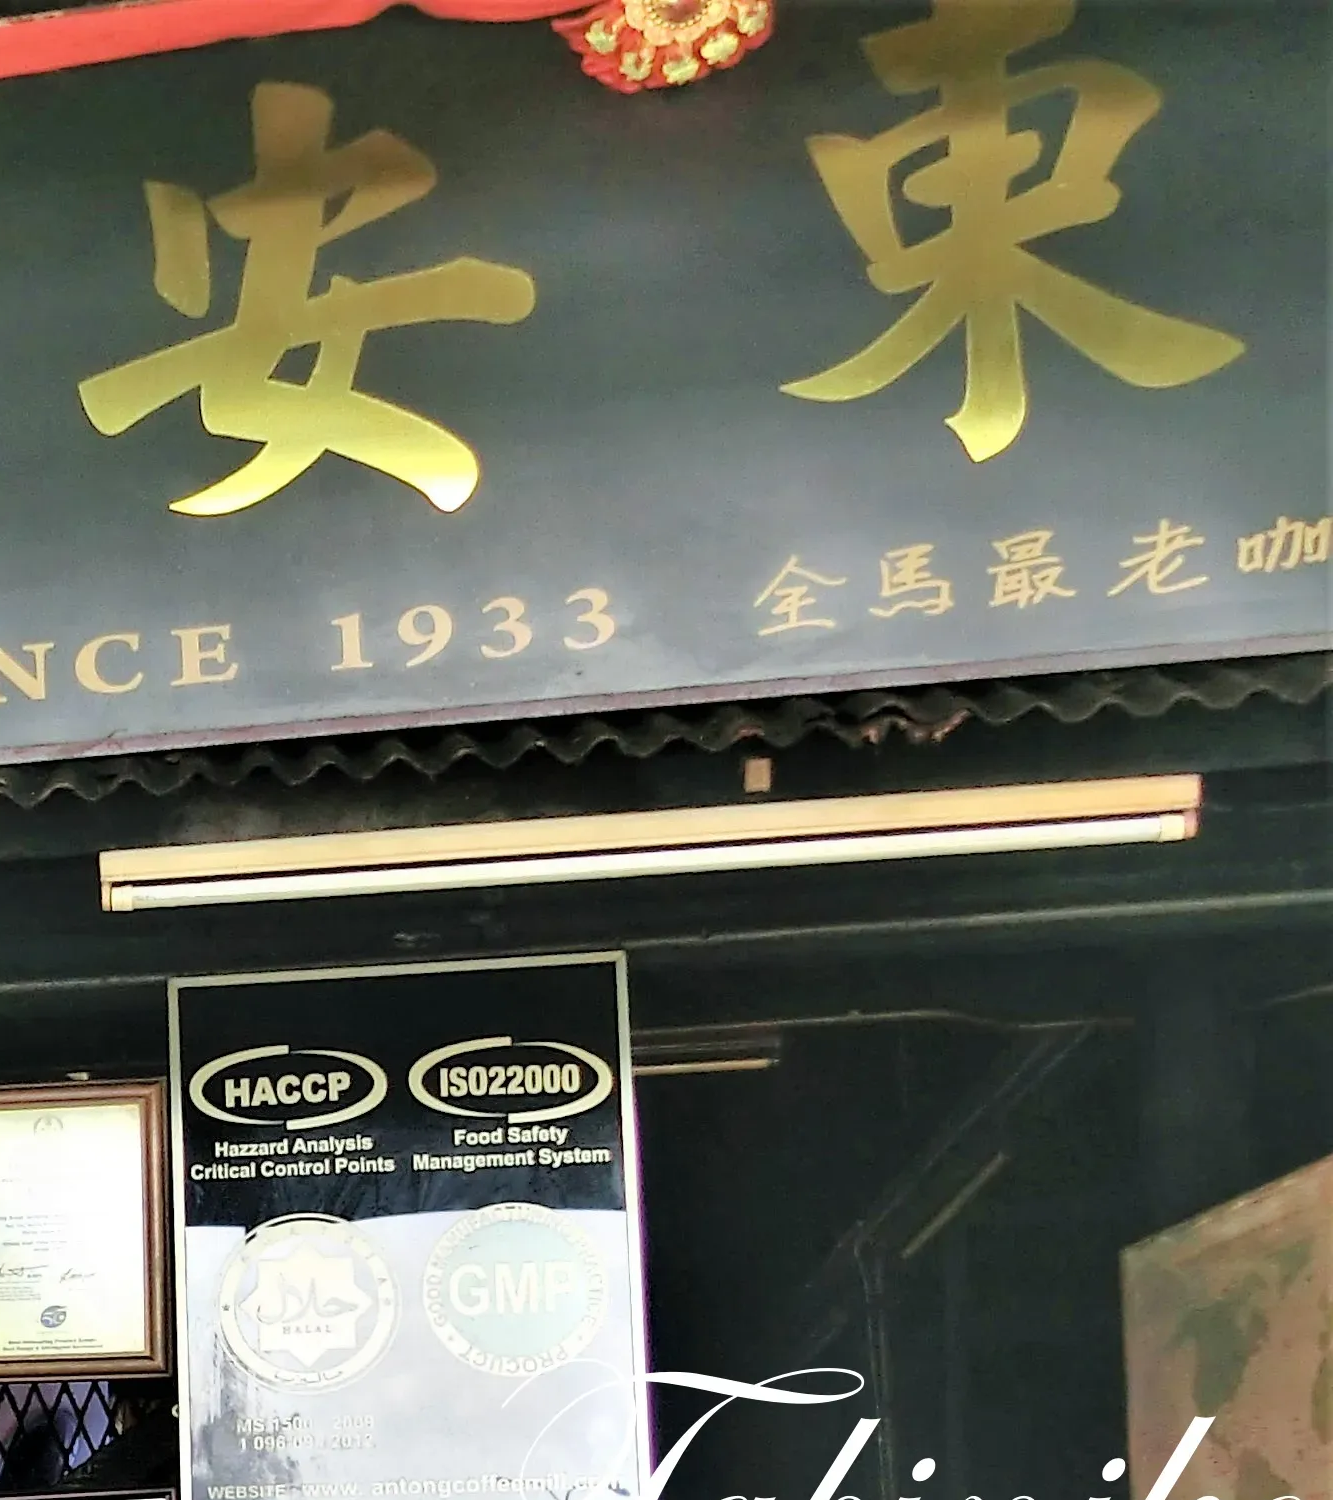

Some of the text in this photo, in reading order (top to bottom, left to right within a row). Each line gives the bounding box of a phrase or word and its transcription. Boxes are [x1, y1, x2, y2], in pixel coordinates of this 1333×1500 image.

[330, 588, 616, 671] 1933
[225, 1071, 351, 1108] HACCP
[440, 1064, 581, 1097] ISO22000
[215, 1134, 373, 1158] Hazzard Analysis
[454, 1126, 568, 1146] Food Safety
[190, 1156, 395, 1181] Critical Control Points
[413, 1148, 610, 1172] Management System
[449, 1260, 574, 1316] GMP
[236, 1417, 264, 1433] MS
[207, 1484, 286, 1499] WEBSITE
